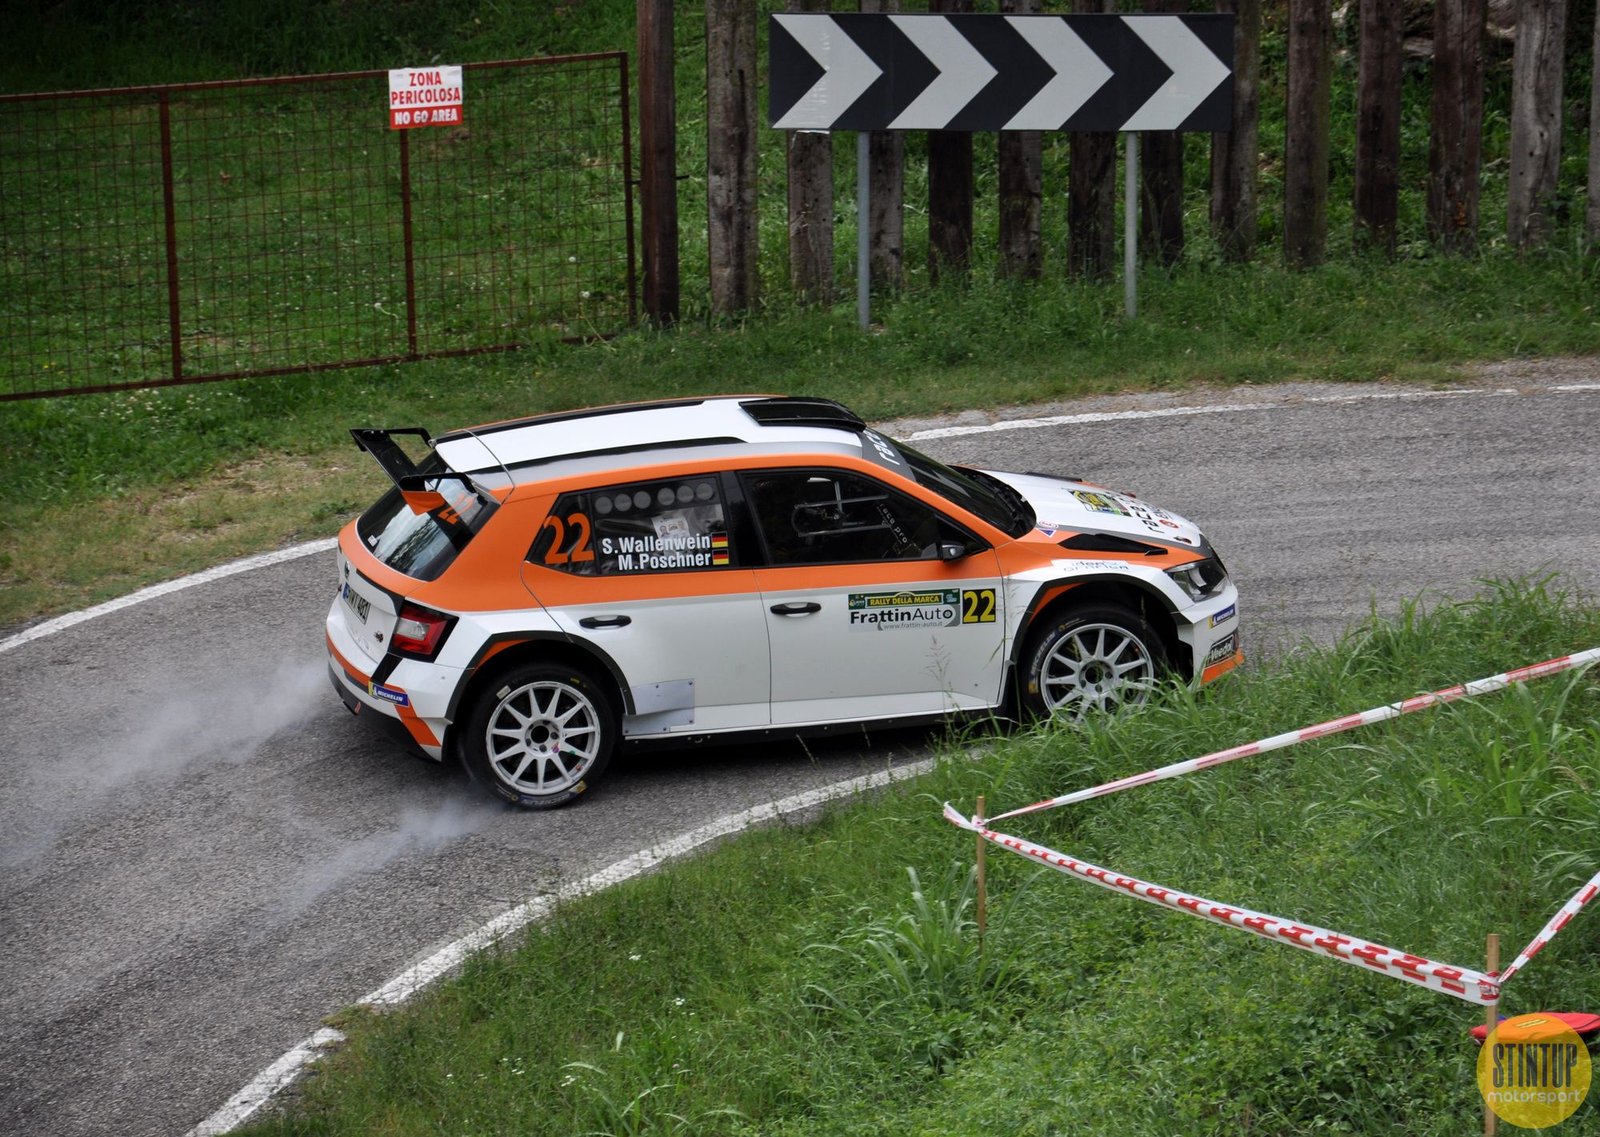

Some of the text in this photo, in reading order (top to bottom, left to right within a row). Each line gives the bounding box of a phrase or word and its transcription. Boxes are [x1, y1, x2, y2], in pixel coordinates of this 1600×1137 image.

[409, 71, 442, 86] ZONA
[391, 87, 461, 105] PERICOLOSA
[394, 108, 458, 125] NO GO AREA
[543, 512, 595, 565] 22
[602, 533, 712, 555] S.Wallenwein
[618, 552, 712, 571] M.Poschner
[869, 598, 891, 606] RALLY
[892, 596, 913, 605] DELLA
[913, 595, 940, 604] MARCA
[962, 589, 995, 623] 22
[850, 607, 953, 625] FrattinAuto
